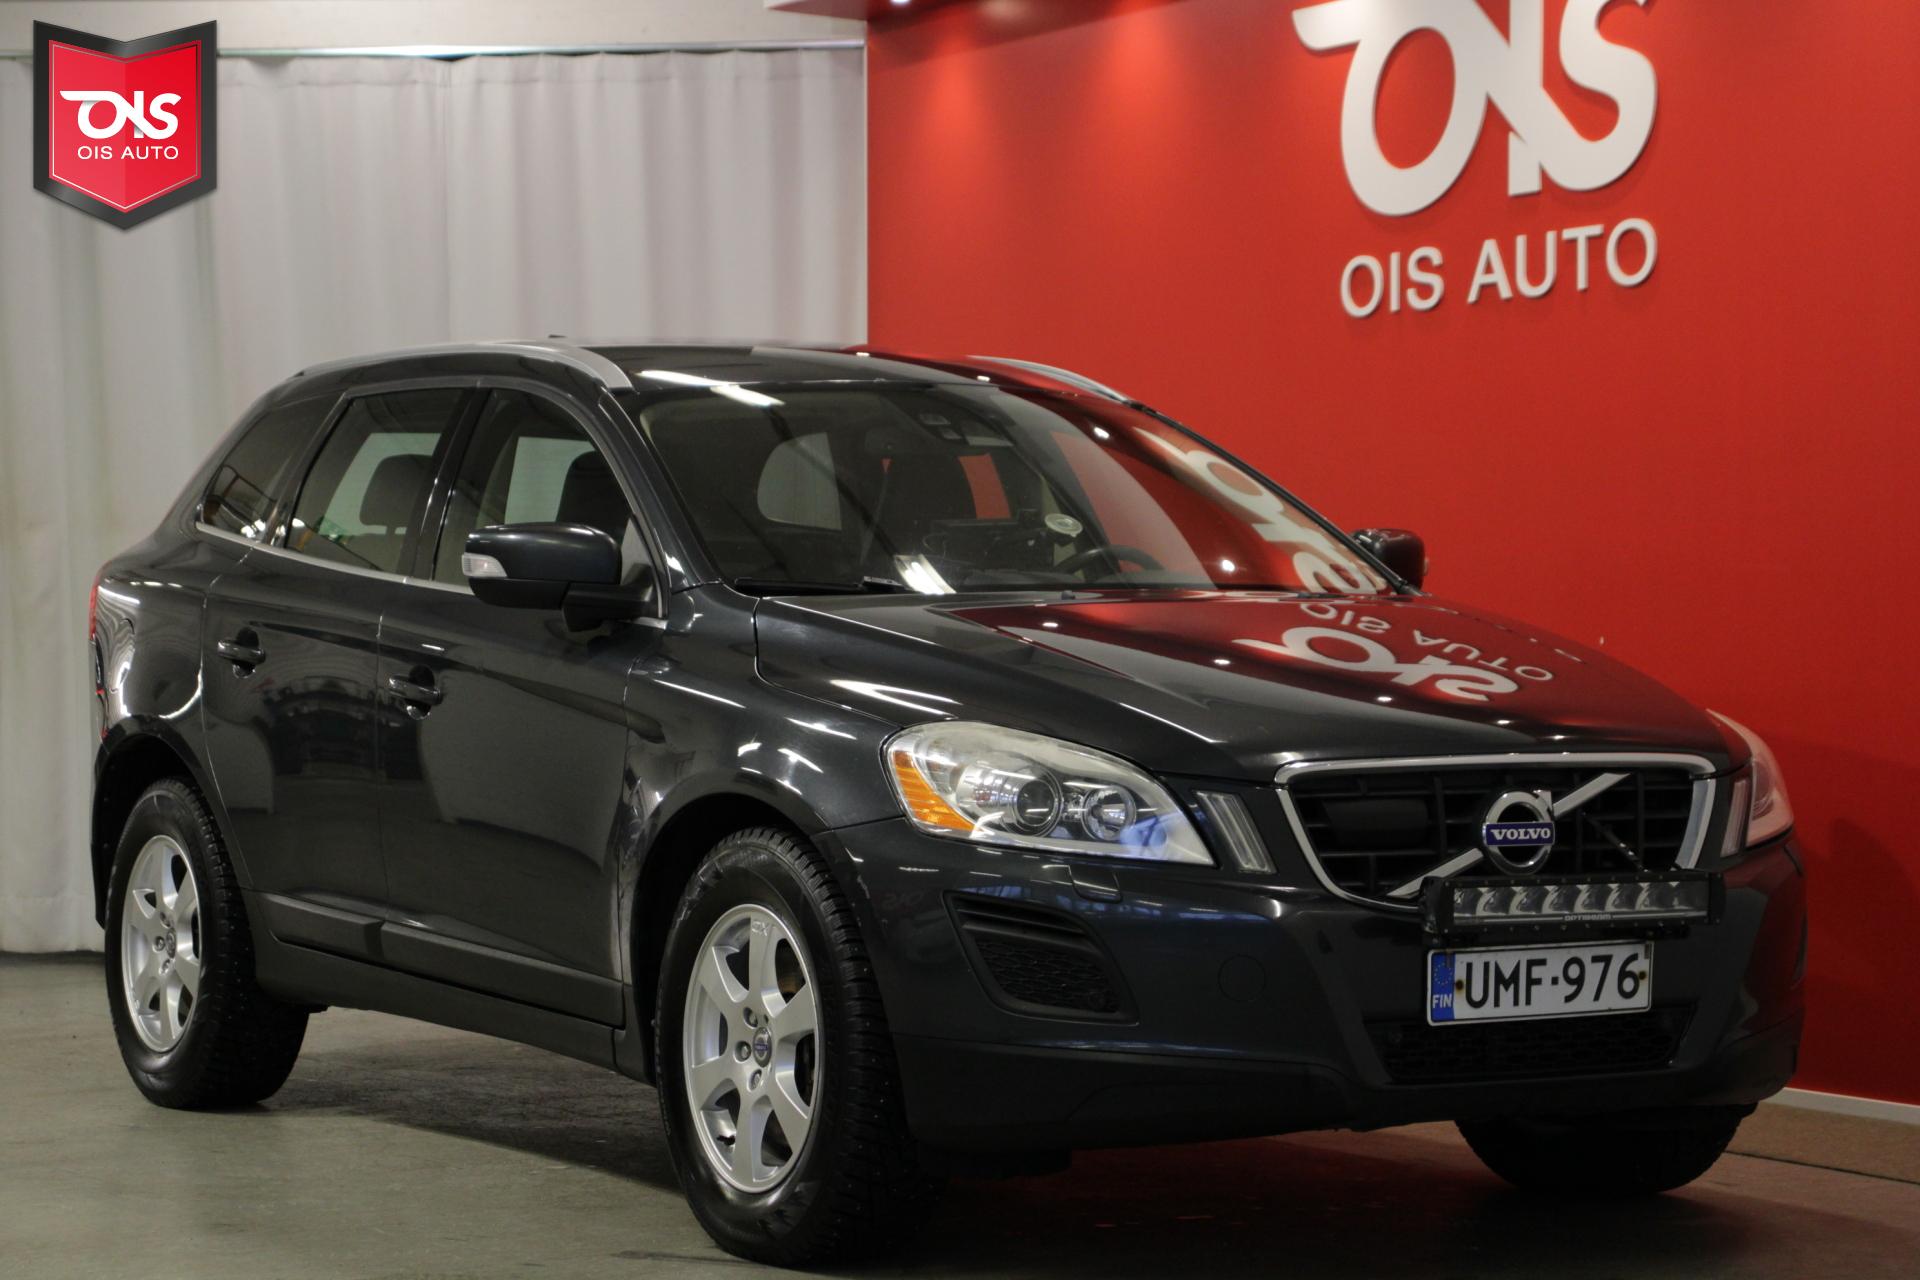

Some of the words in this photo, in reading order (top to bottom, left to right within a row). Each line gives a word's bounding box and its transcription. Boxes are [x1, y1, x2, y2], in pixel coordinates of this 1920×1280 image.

[1340, 247, 1444, 318] OIS
[1467, 218, 1658, 304] AUTO
[1490, 828, 1551, 840] VOLVO
[1464, 954, 1640, 1009] UMF-976
[1432, 994, 1452, 1009] FIN
